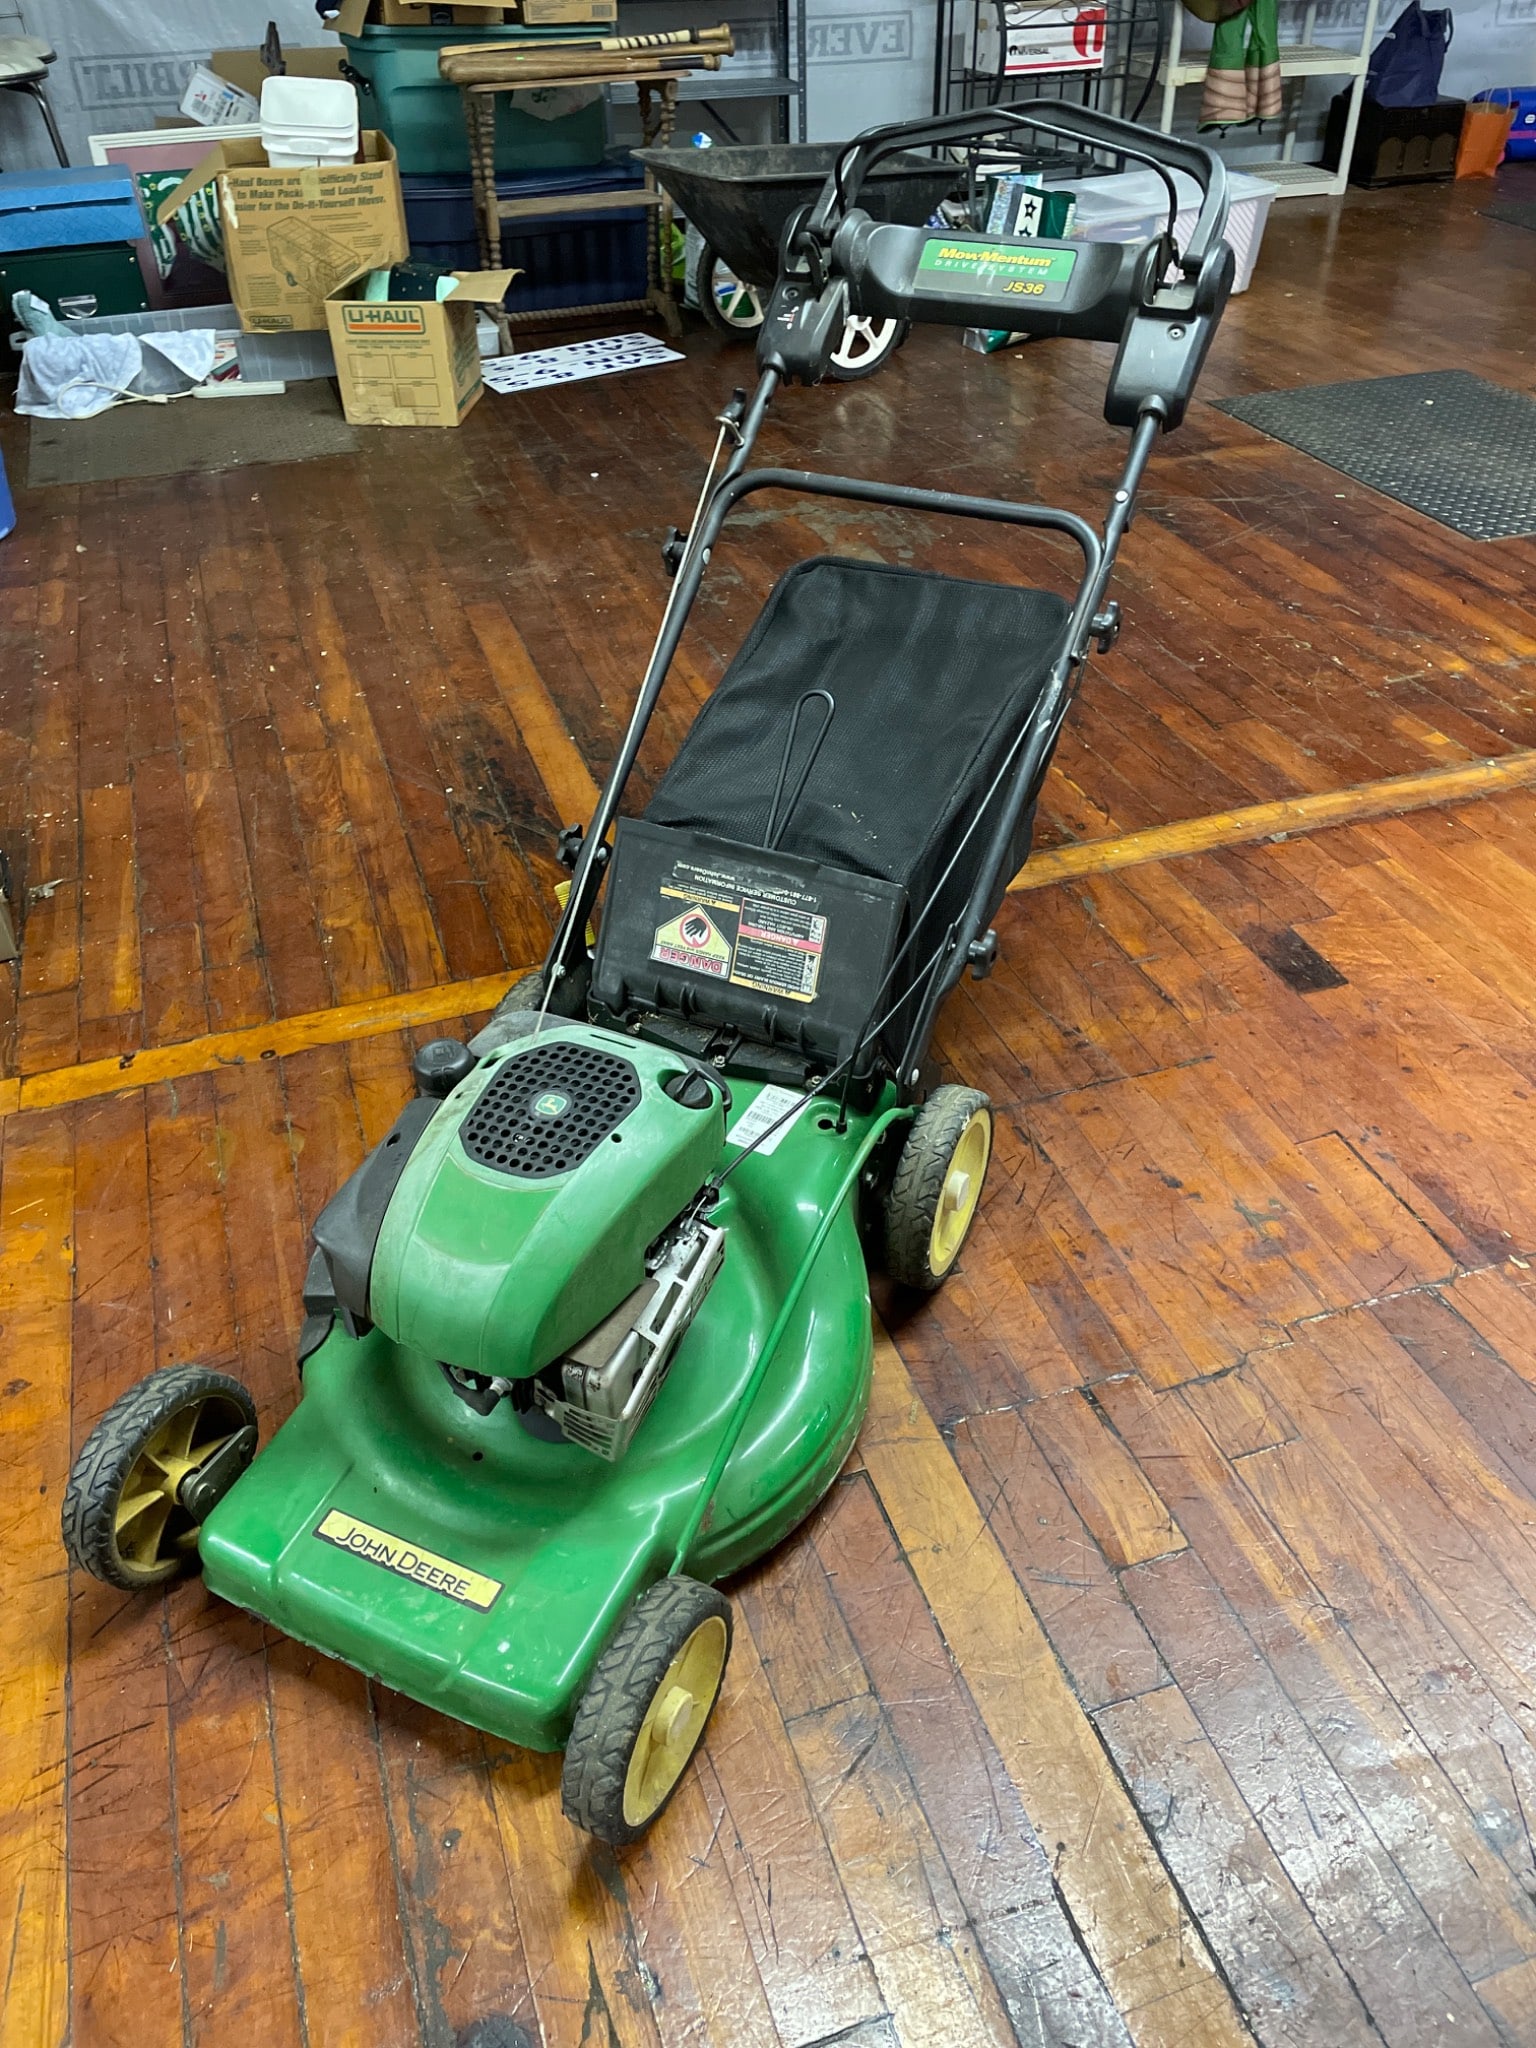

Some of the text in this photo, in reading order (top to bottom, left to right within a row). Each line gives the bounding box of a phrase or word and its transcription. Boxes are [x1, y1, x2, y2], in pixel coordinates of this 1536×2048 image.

[934, 259, 1049, 276] DRIVE SYSTEM
[1002, 281, 1046, 295] JS36
[348, 309, 419, 323] U-HAUL
[693, 874, 735, 890] INFORMATION
[760, 931, 792, 944] DANGER
[658, 947, 723, 975] DANGER
[335, 1528, 471, 1596] JOHN DEERE
